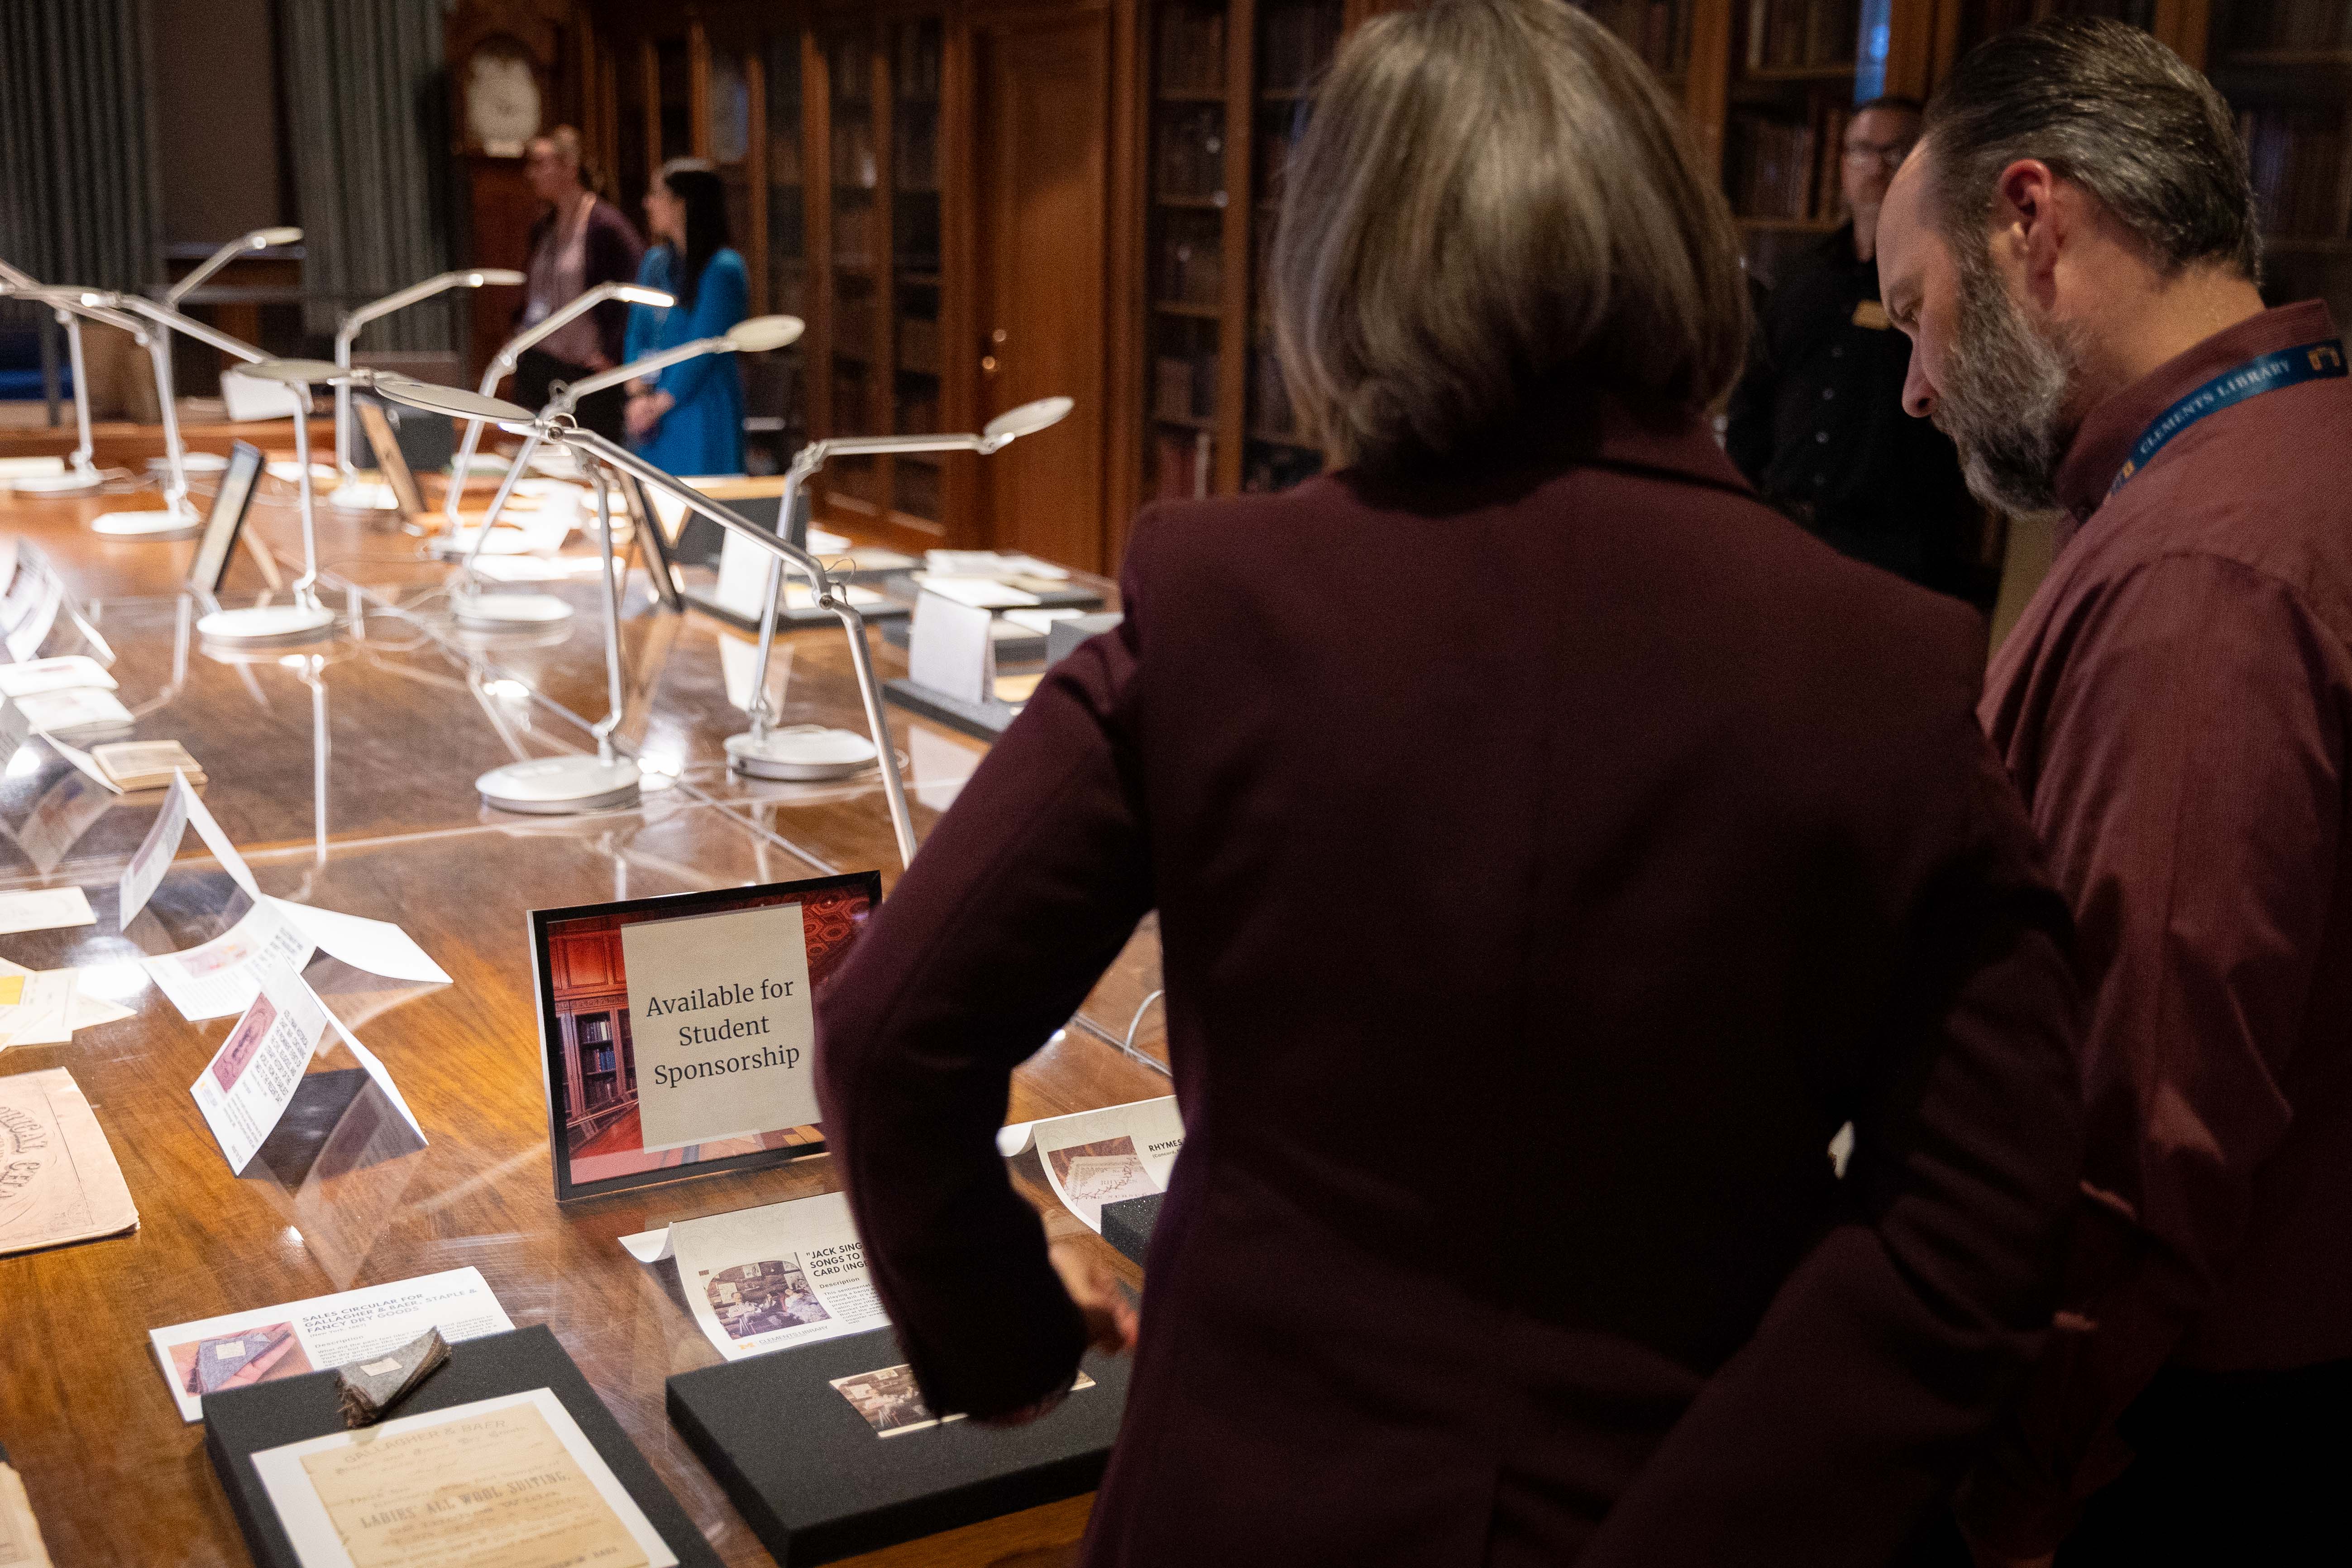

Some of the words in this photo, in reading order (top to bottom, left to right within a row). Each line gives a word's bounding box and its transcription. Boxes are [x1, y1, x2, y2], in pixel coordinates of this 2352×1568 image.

[2139, 392, 2215, 454] CLEMENTS
[2216, 358, 2291, 397] LIBRARY
[646, 984, 754, 1017] Available
[760, 979, 794, 999] for
[679, 1016, 770, 1046] Student
[655, 1045, 800, 1088] Sponsorship
[1148, 1139, 1182, 1152] RHYMES
[806, 1247, 837, 1259] "JACK
[810, 1256, 845, 1268] SONGS
[813, 1266, 840, 1276] CARD
[819, 1277, 860, 1289] Description
[837, 1283, 870, 1293] sentimental
[302, 1311, 338, 1322] SALES
[341, 1299, 398, 1314] CIRCULAR
[401, 1293, 424, 1302] FOR
[305, 1309, 374, 1328] GALLAGHER
[425, 1290, 465, 1302] STAPLE
[306, 1320, 349, 1334] FANCY
[350, 1316, 373, 1325] DRY
[377, 1306, 420, 1319] GOODS
[314, 1334, 364, 1348] Description
[344, 1429, 441, 1463] GALLAGHER
[426, 1496, 456, 1515] ALL
[459, 1487, 504, 1507] WOOL
